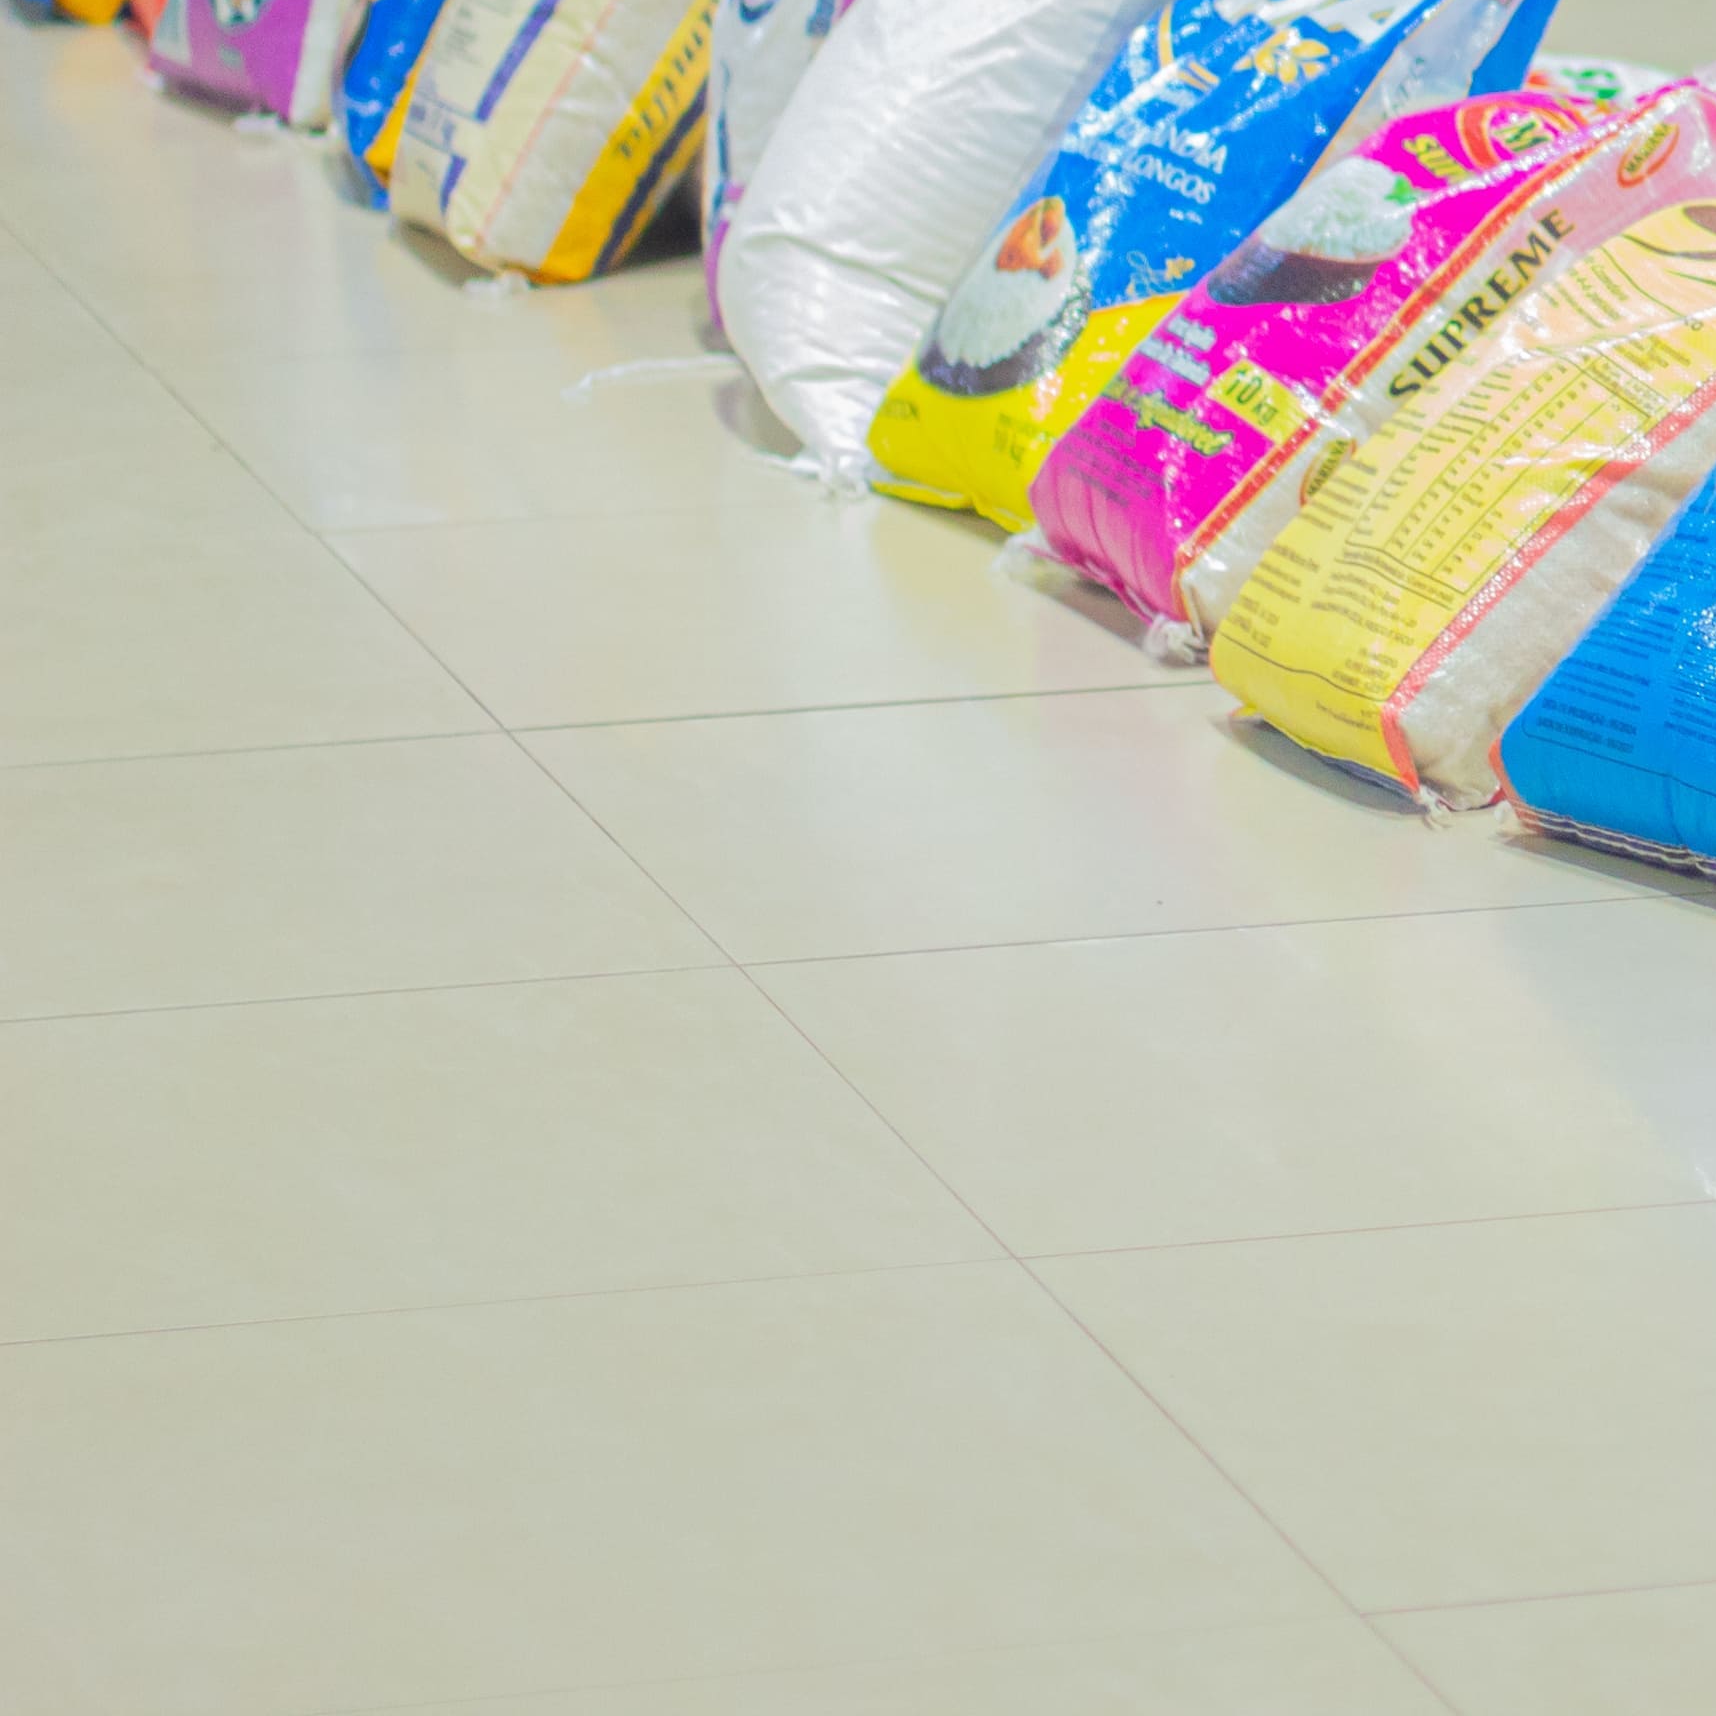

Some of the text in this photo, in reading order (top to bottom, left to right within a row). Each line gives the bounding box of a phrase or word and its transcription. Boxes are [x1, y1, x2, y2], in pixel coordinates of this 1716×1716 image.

[1389, 209, 1576, 398] SUPREME
[1225, 369, 1279, 426] 10 kg
